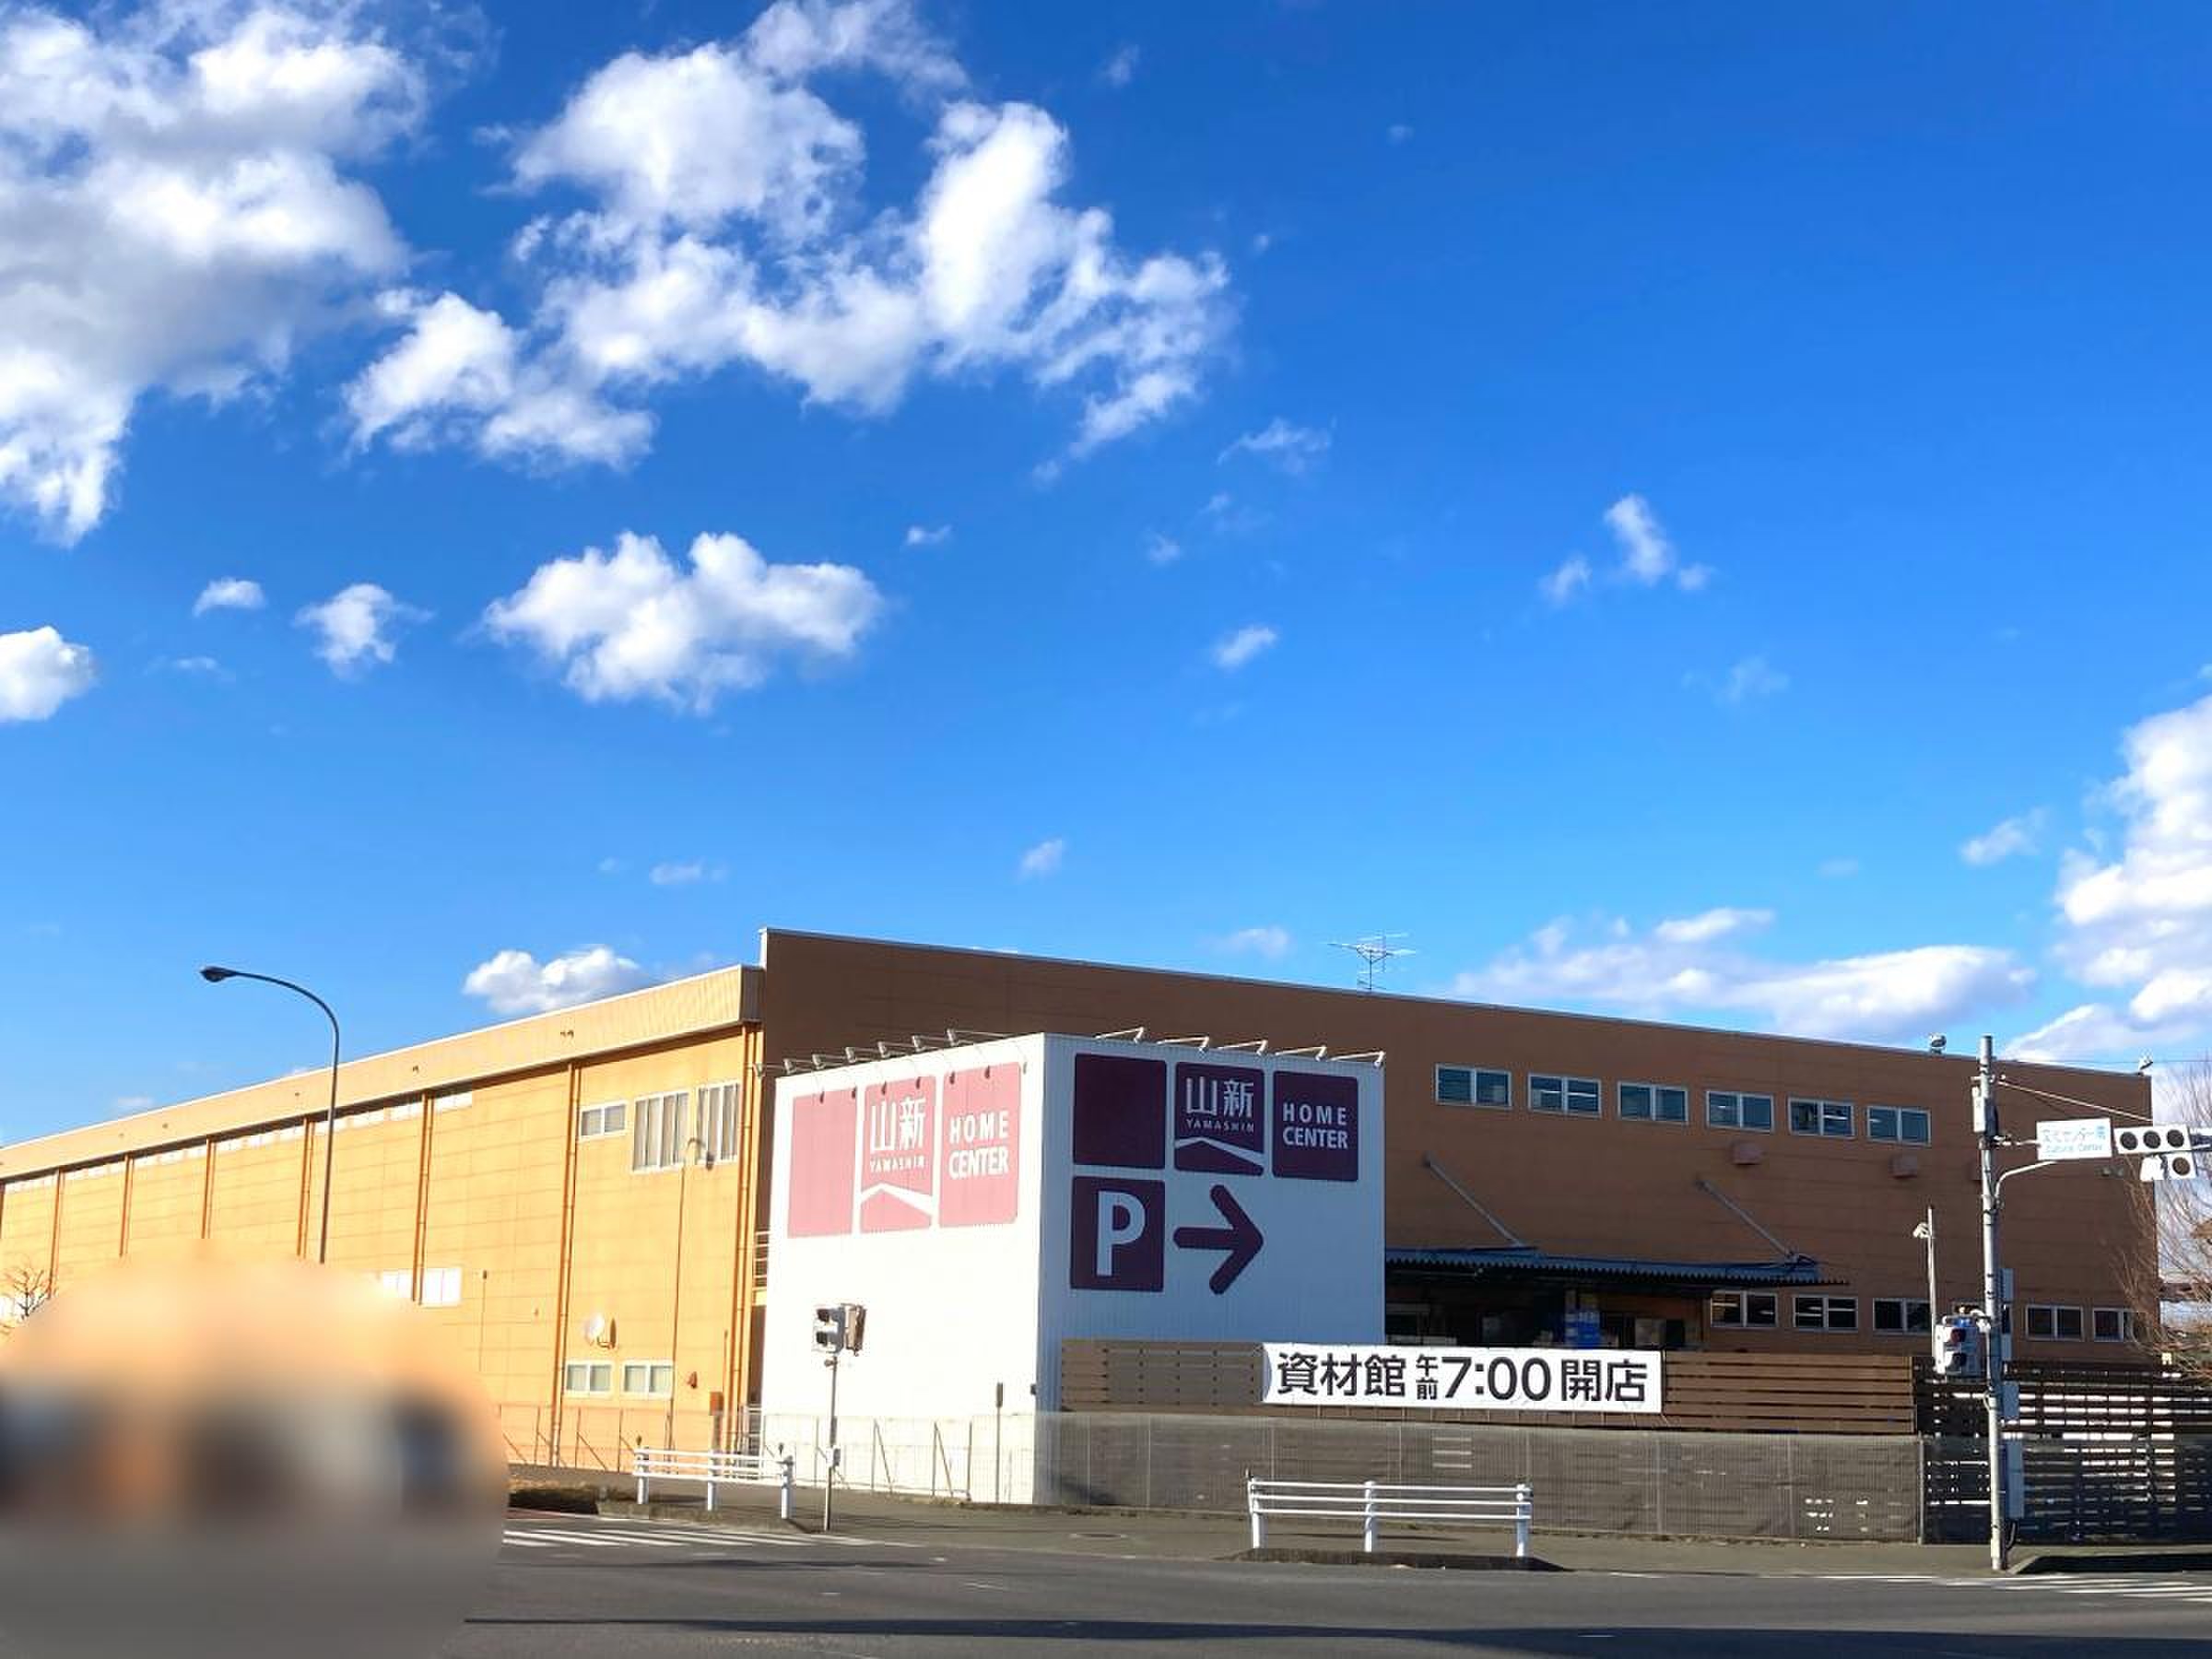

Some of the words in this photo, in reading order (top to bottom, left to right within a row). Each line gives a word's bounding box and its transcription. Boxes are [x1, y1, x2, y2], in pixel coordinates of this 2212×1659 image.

[1186, 1076, 1253, 1117] 山新
[871, 1097, 926, 1154] 山新
[949, 1111, 1009, 1144] HOME
[1186, 1118, 1253, 1133] YAMASHIN
[1283, 1102, 1347, 1125] HOME
[1283, 1126, 1347, 1148] CENTER
[948, 1146, 1008, 1180] CENTER
[1097, 1191, 1146, 1276] P
